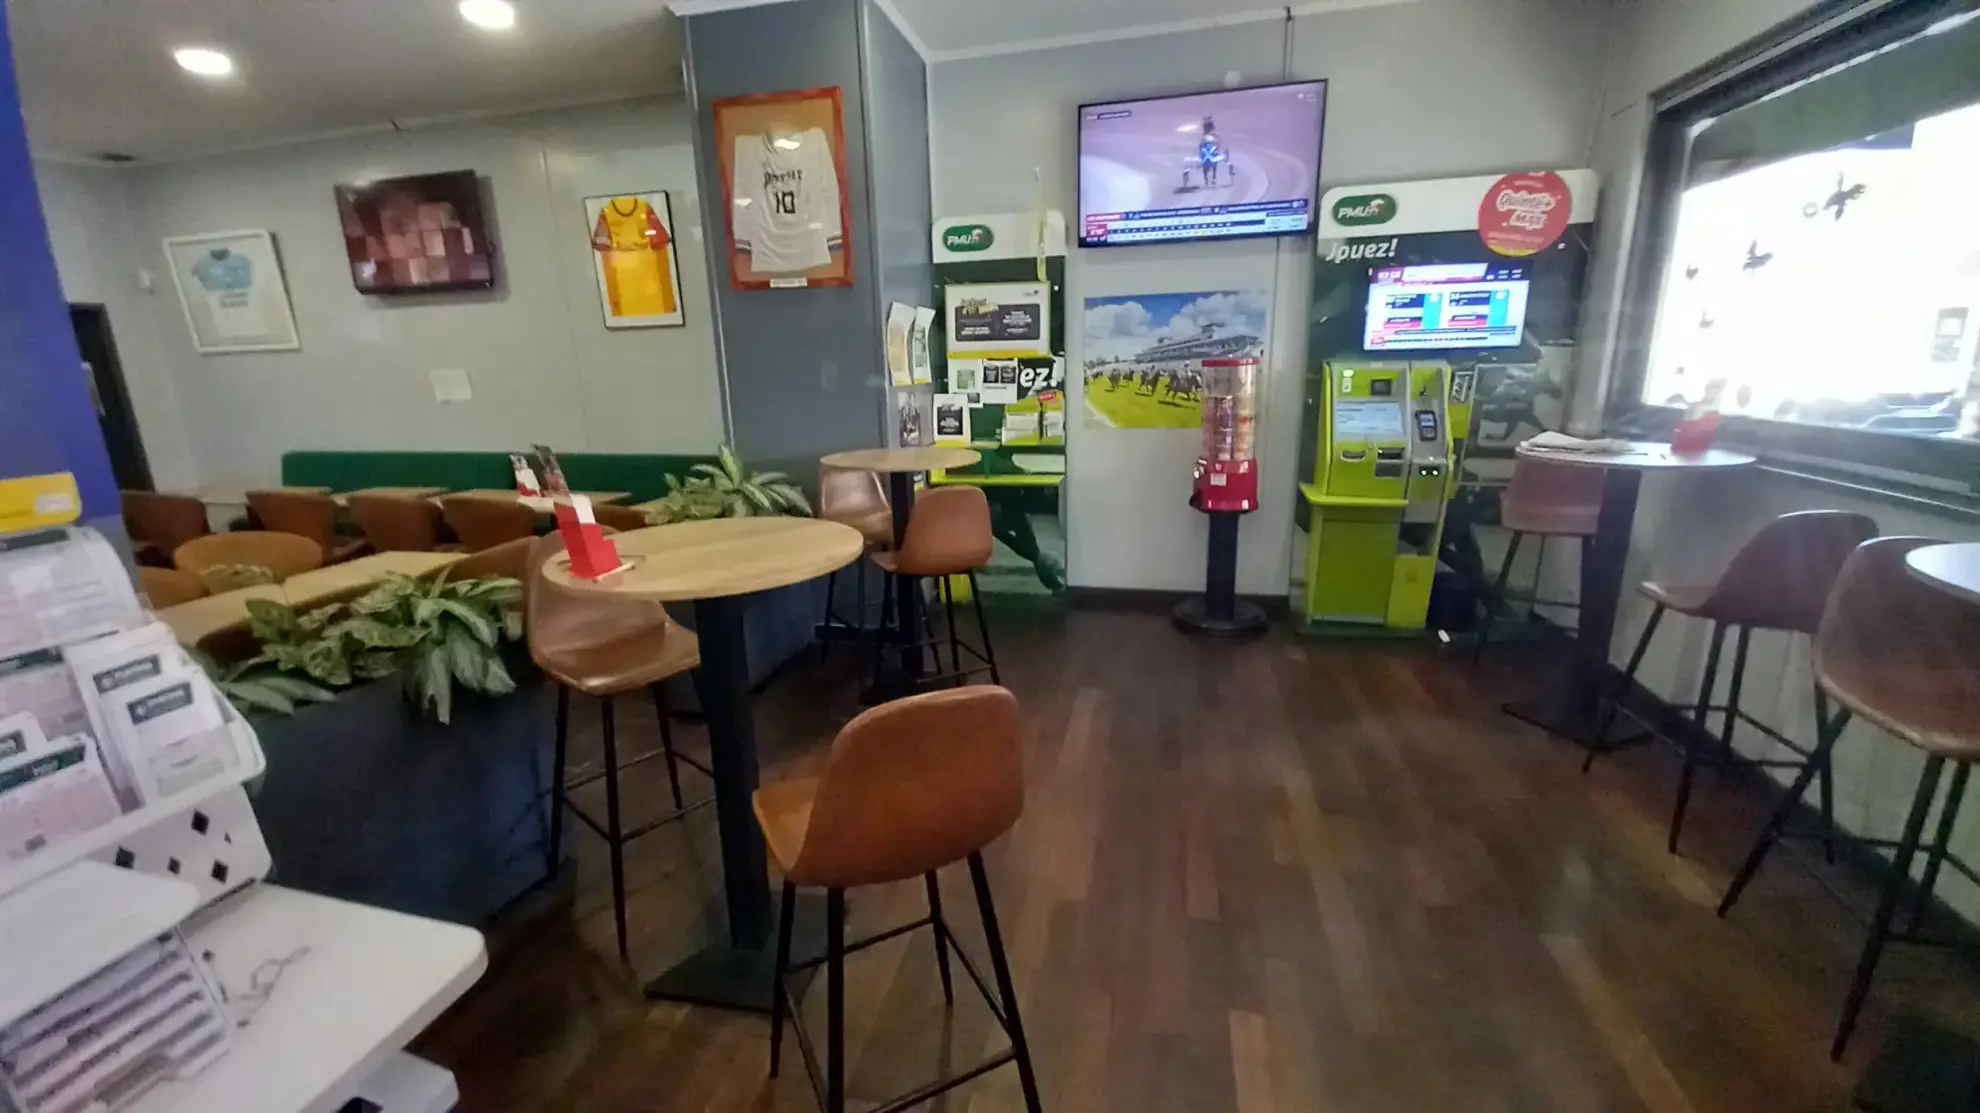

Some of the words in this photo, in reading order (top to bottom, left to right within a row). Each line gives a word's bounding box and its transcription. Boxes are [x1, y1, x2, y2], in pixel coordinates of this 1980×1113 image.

[775, 190, 796, 214] 10
[1337, 205, 1371, 219] PMU
[947, 234, 973, 246] PMU
